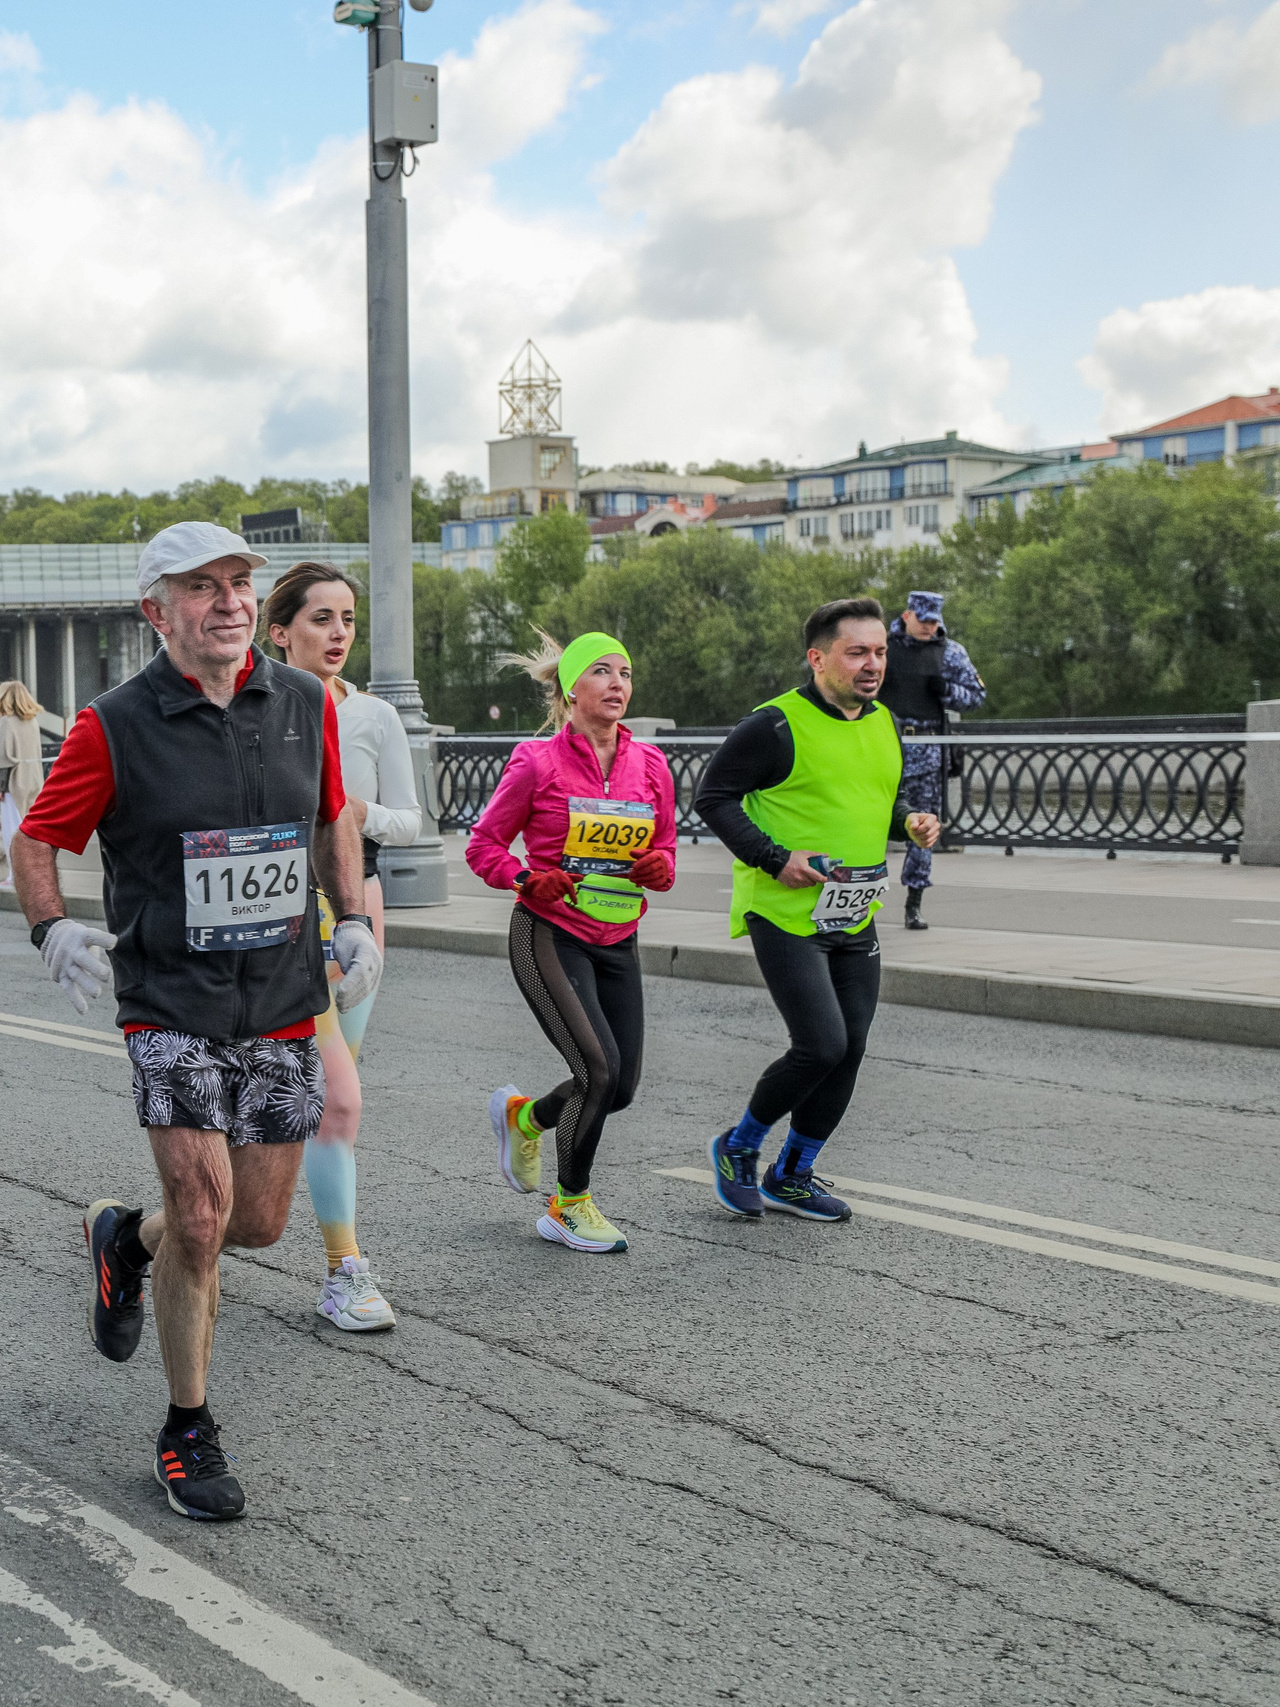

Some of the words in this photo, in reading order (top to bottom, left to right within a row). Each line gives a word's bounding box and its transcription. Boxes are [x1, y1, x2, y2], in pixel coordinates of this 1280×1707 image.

[577, 819, 649, 848] 12039
[195, 859, 299, 905] 11626
[231, 903, 272, 916] ВИКТОР
[598, 899, 637, 911] DEMIX
[199, 928, 215, 946] F
[558, 1212, 579, 1233] HOKA
